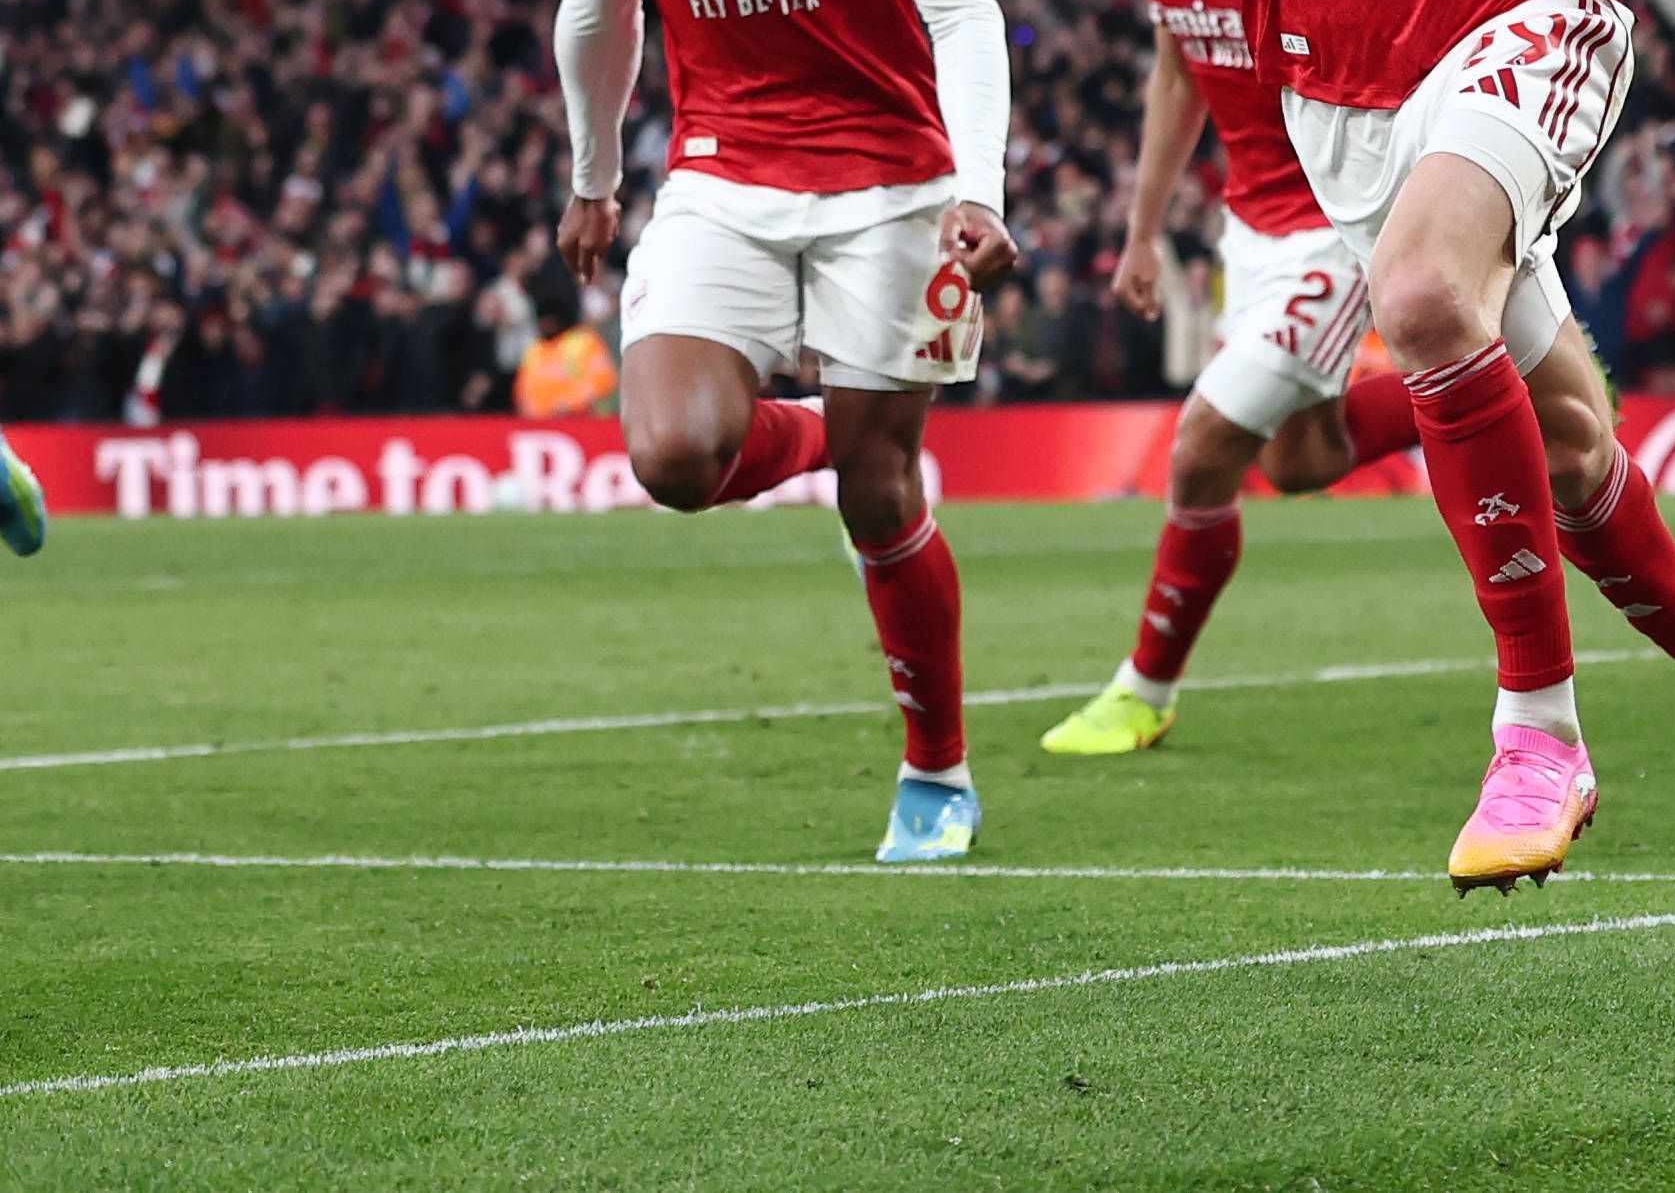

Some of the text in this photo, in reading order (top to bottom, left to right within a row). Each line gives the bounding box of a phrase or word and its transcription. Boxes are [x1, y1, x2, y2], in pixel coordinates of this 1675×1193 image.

[926, 259, 969, 323] 6
[1285, 270, 1334, 328] 2
[95, 430, 368, 518] Time
[377, 437, 492, 516] to
